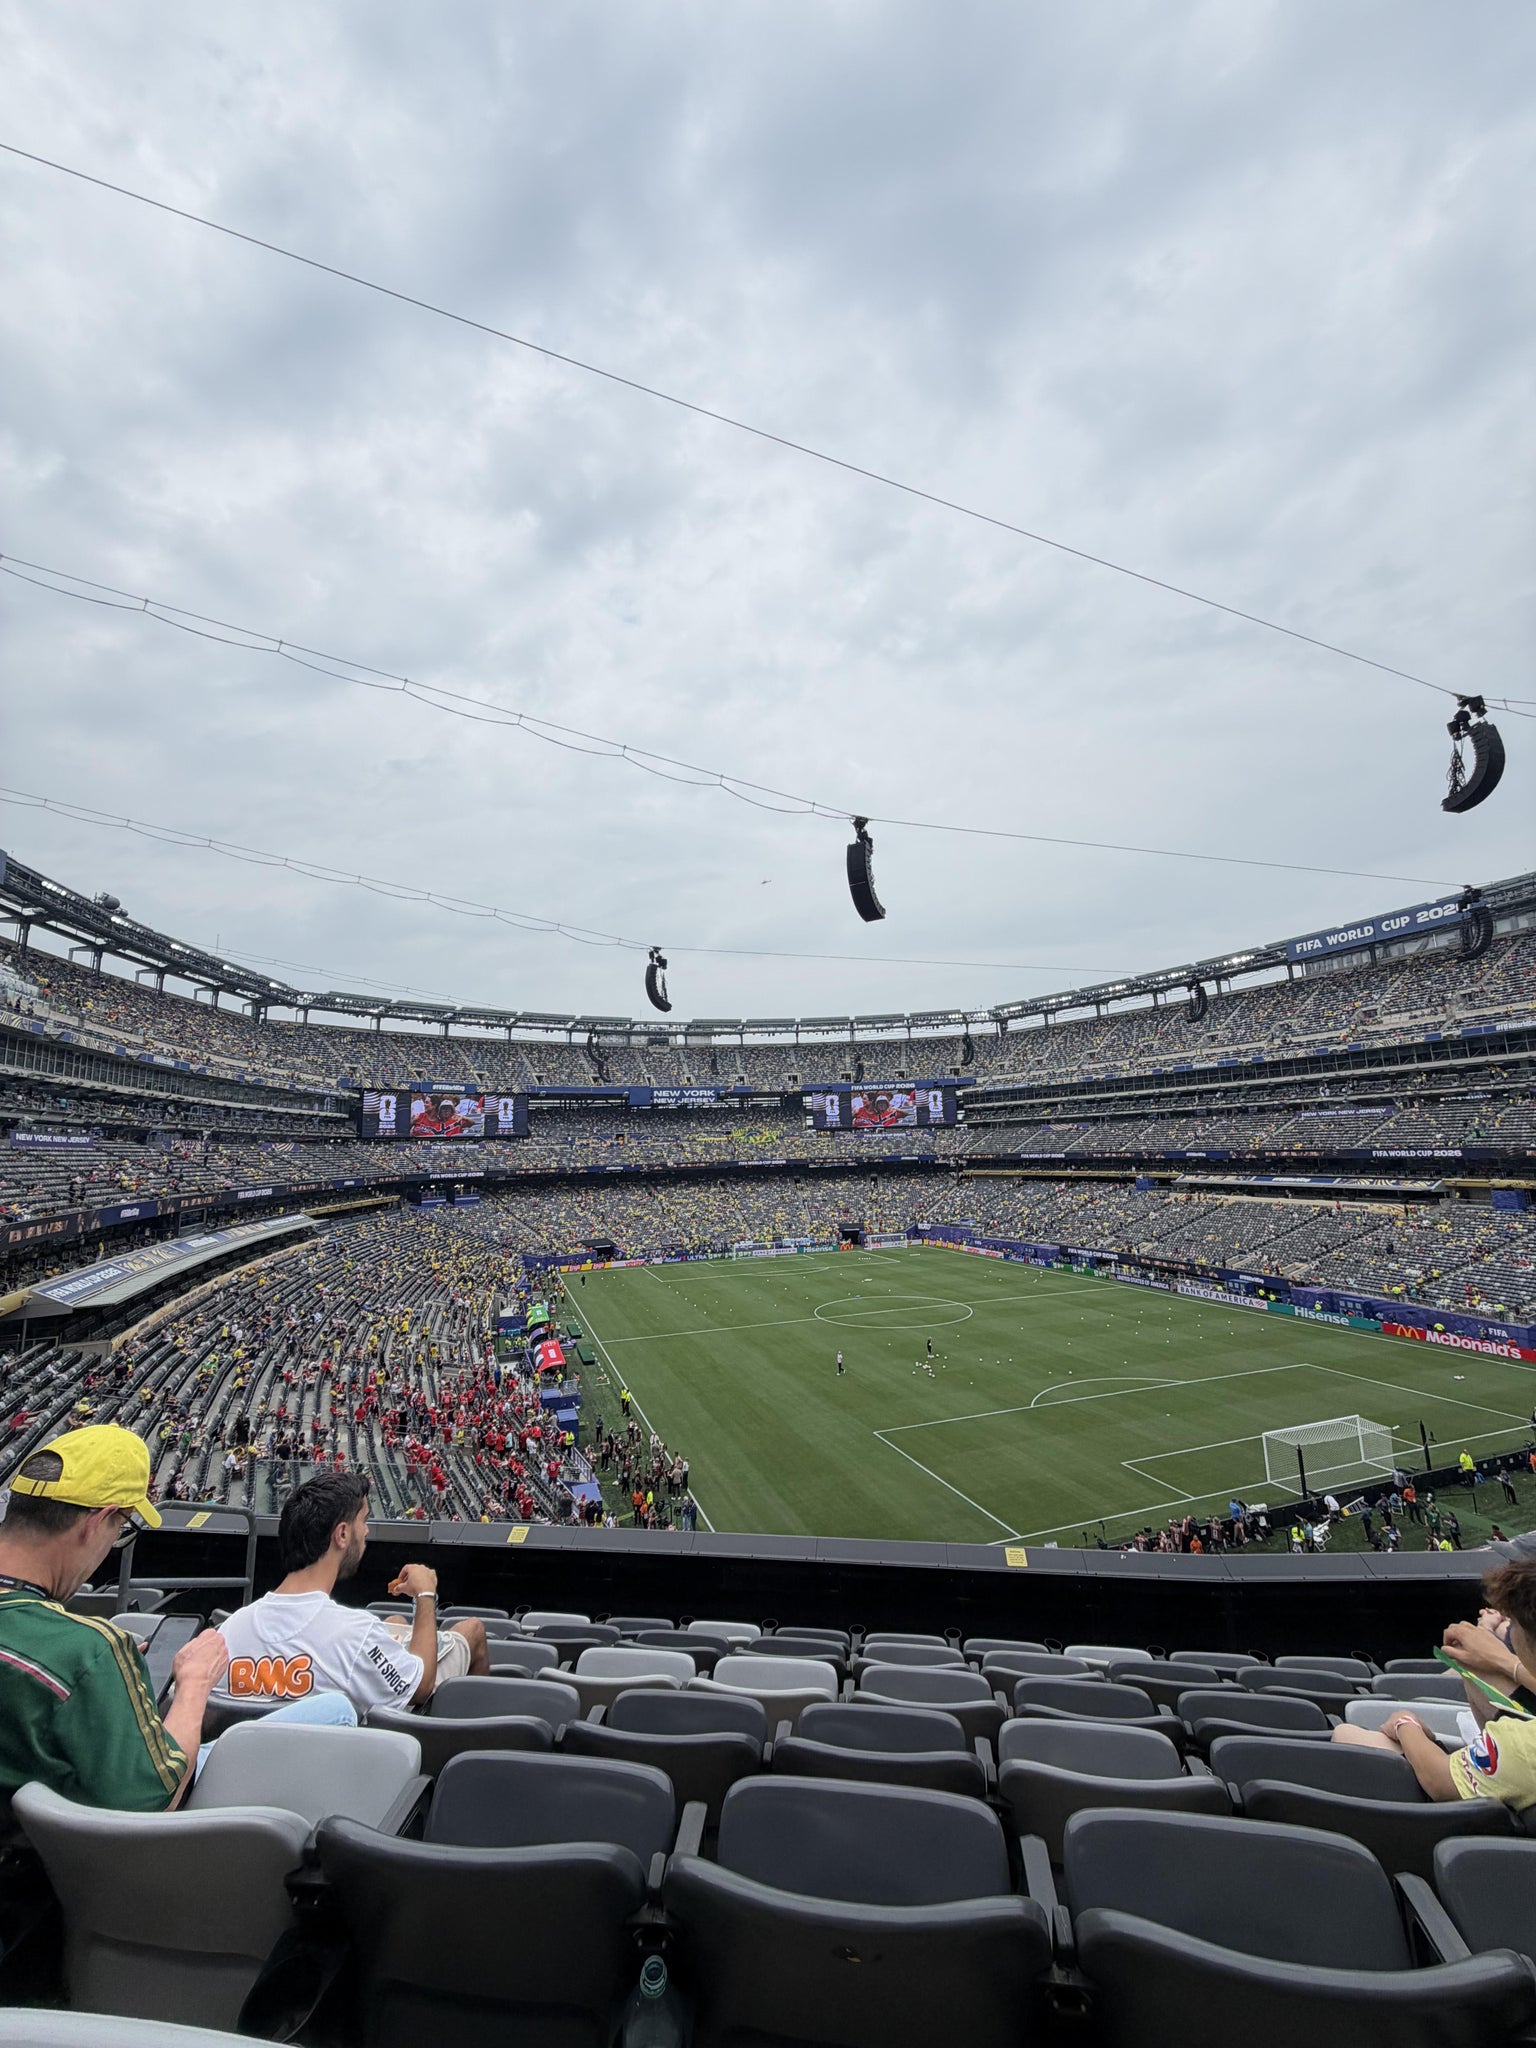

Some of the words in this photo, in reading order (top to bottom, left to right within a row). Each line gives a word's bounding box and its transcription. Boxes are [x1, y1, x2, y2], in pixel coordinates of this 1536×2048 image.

[1295, 939, 1323, 954] FIFA
[1326, 925, 1374, 946] WORLD
[1381, 916, 1411, 932] CUP
[15, 1133, 33, 1141] NEW
[34, 1134, 52, 1142] YORK
[67, 1136, 90, 1144] JERSEY
[1116, 1274, 1130, 1282] UNITED
[1150, 1281, 1170, 1290] AMERICA
[1180, 1286, 1202, 1296] BANK
[1203, 1290, 1214, 1298] OF
[1215, 1292, 1254, 1306] AMERICA
[1294, 1305, 1350, 1326] Hisense
[1488, 1327, 1509, 1338] FIFA
[1425, 1330, 1522, 1360] McDonald's
[229, 1653, 314, 1699] BMG
[367, 1645, 411, 1696] NETSHOES
